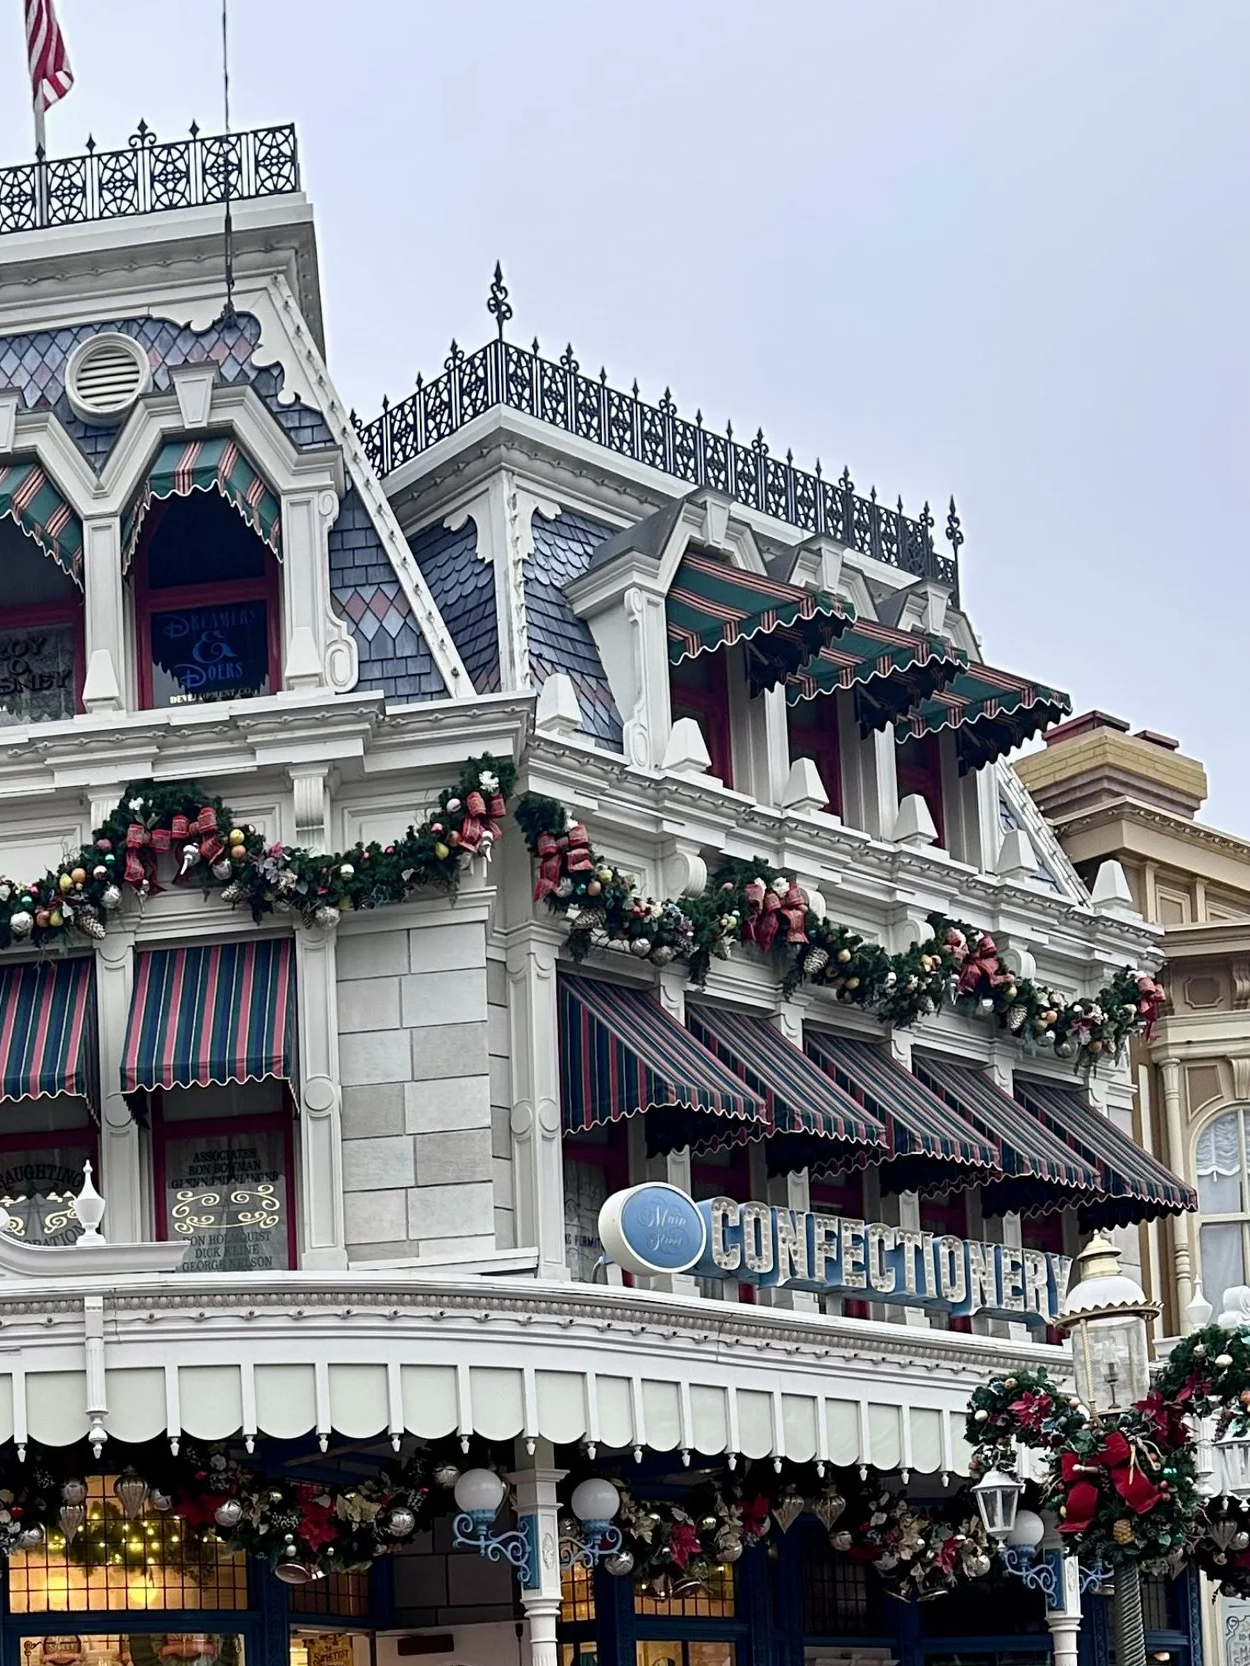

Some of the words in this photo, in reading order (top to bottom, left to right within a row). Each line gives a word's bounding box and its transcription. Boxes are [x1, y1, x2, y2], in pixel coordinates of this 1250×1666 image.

[192, 630, 237, 663] &
[174, 662, 243, 687] DOERS
[192, 1148, 258, 1164] ASSOCIATES
[647, 1204, 687, 1228] Main
[649, 1228, 684, 1251] Street
[194, 1246, 222, 1259] DICK
[710, 1196, 1073, 1327] CONFECTIONERY
[182, 1259, 225, 1272] GEORGE
